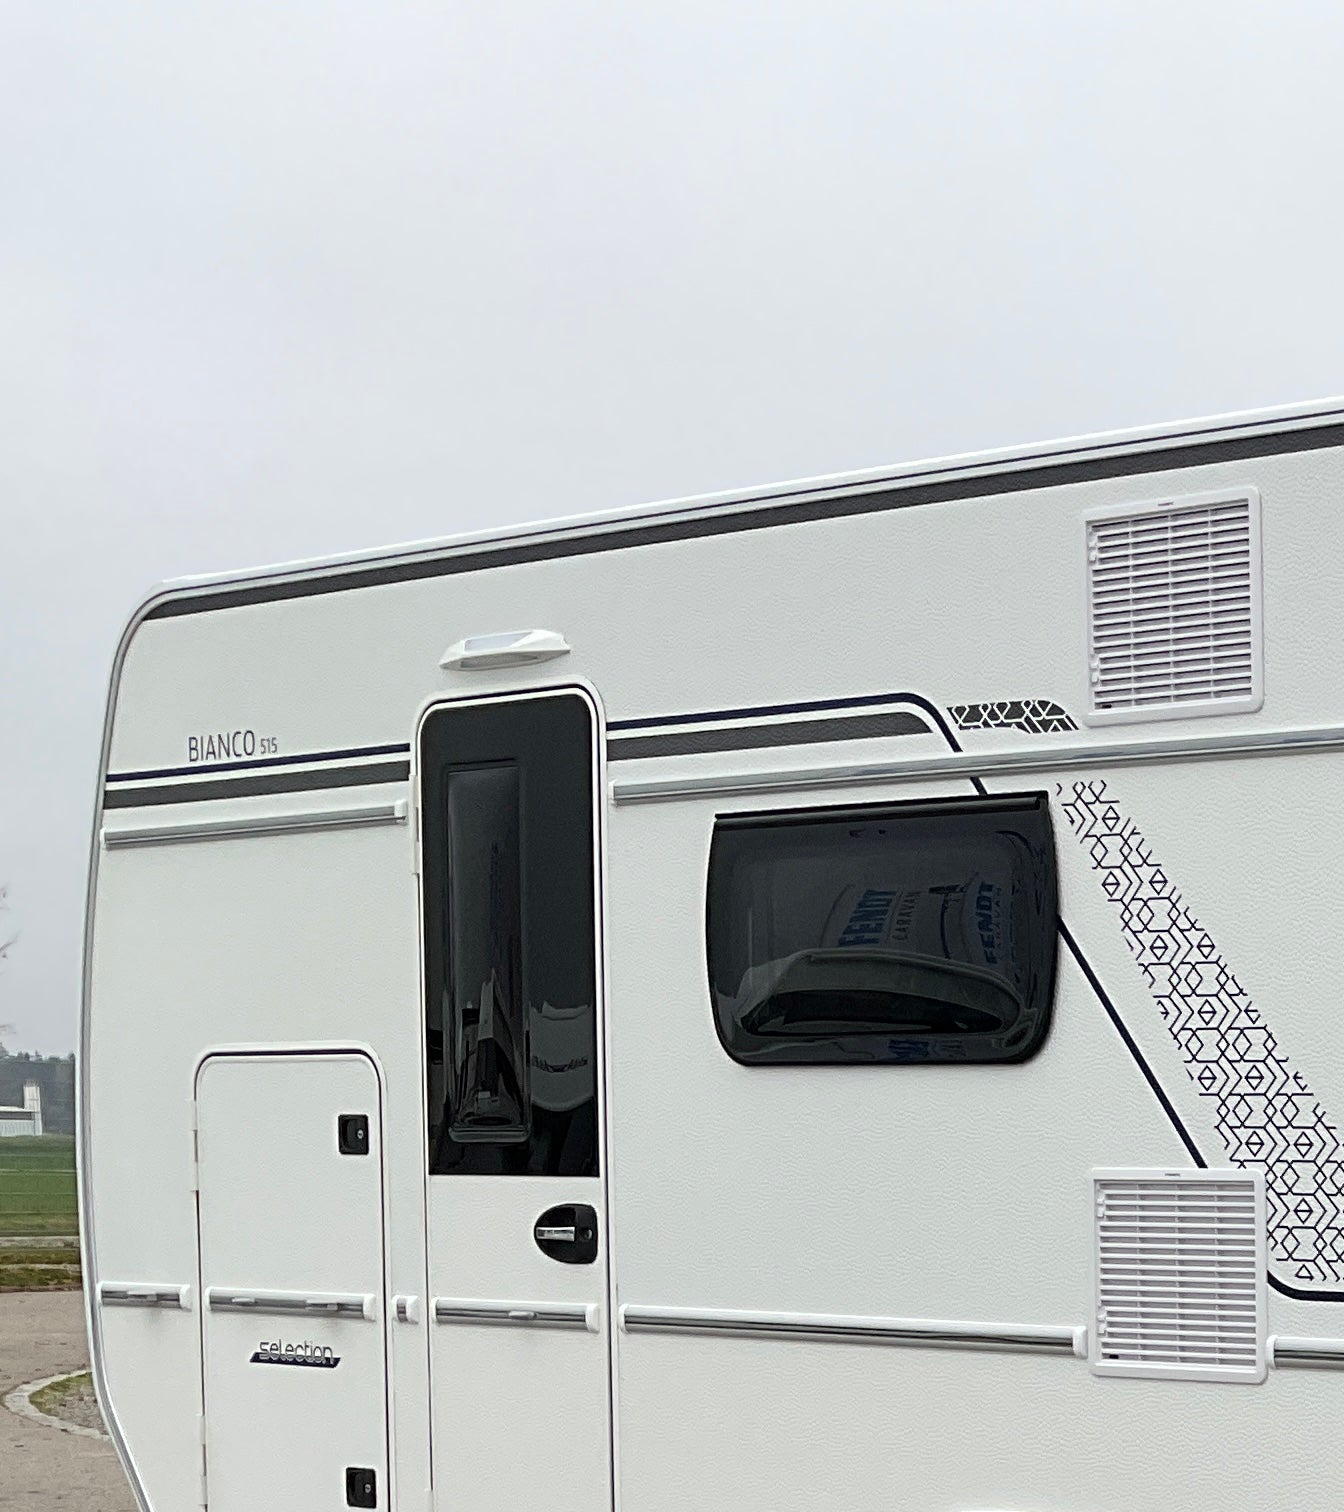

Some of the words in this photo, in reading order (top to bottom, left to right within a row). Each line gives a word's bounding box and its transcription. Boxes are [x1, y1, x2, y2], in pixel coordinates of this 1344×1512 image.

[188, 729, 256, 762] BIANCO
[260, 736, 278, 755] 515
[259, 1338, 334, 1365] selection
